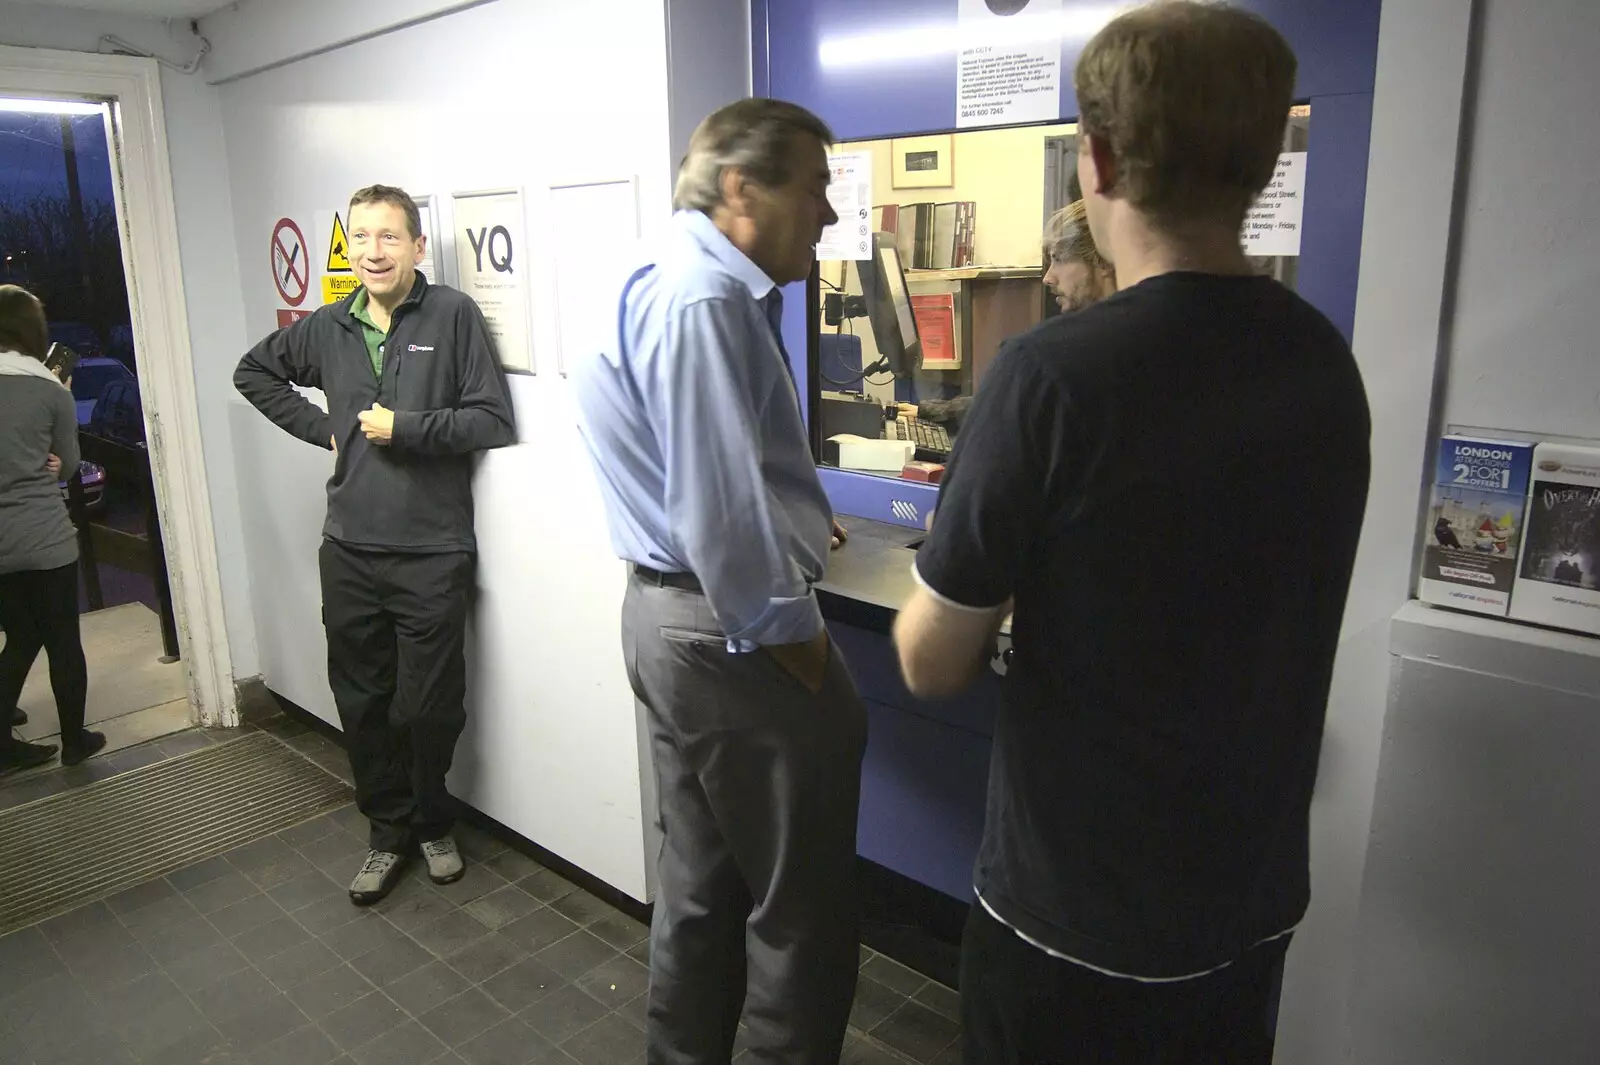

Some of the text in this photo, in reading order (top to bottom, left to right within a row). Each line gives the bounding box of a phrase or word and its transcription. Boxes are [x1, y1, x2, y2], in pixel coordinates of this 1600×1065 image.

[961, 110, 976, 118] 0845
[990, 107, 1004, 115] 7245
[1252, 222, 1274, 230] Monday
[466, 225, 513, 275] YQ
[330, 277, 358, 290] Warning
[291, 312, 300, 322] No
[1455, 446, 1512, 461] LONDON
[1454, 456, 1511, 468] ATTRACTIONS
[1453, 463, 1510, 489] 2 FOR 1
[1470, 478, 1500, 488] OFFERS
[1449, 591, 1503, 606] national express
